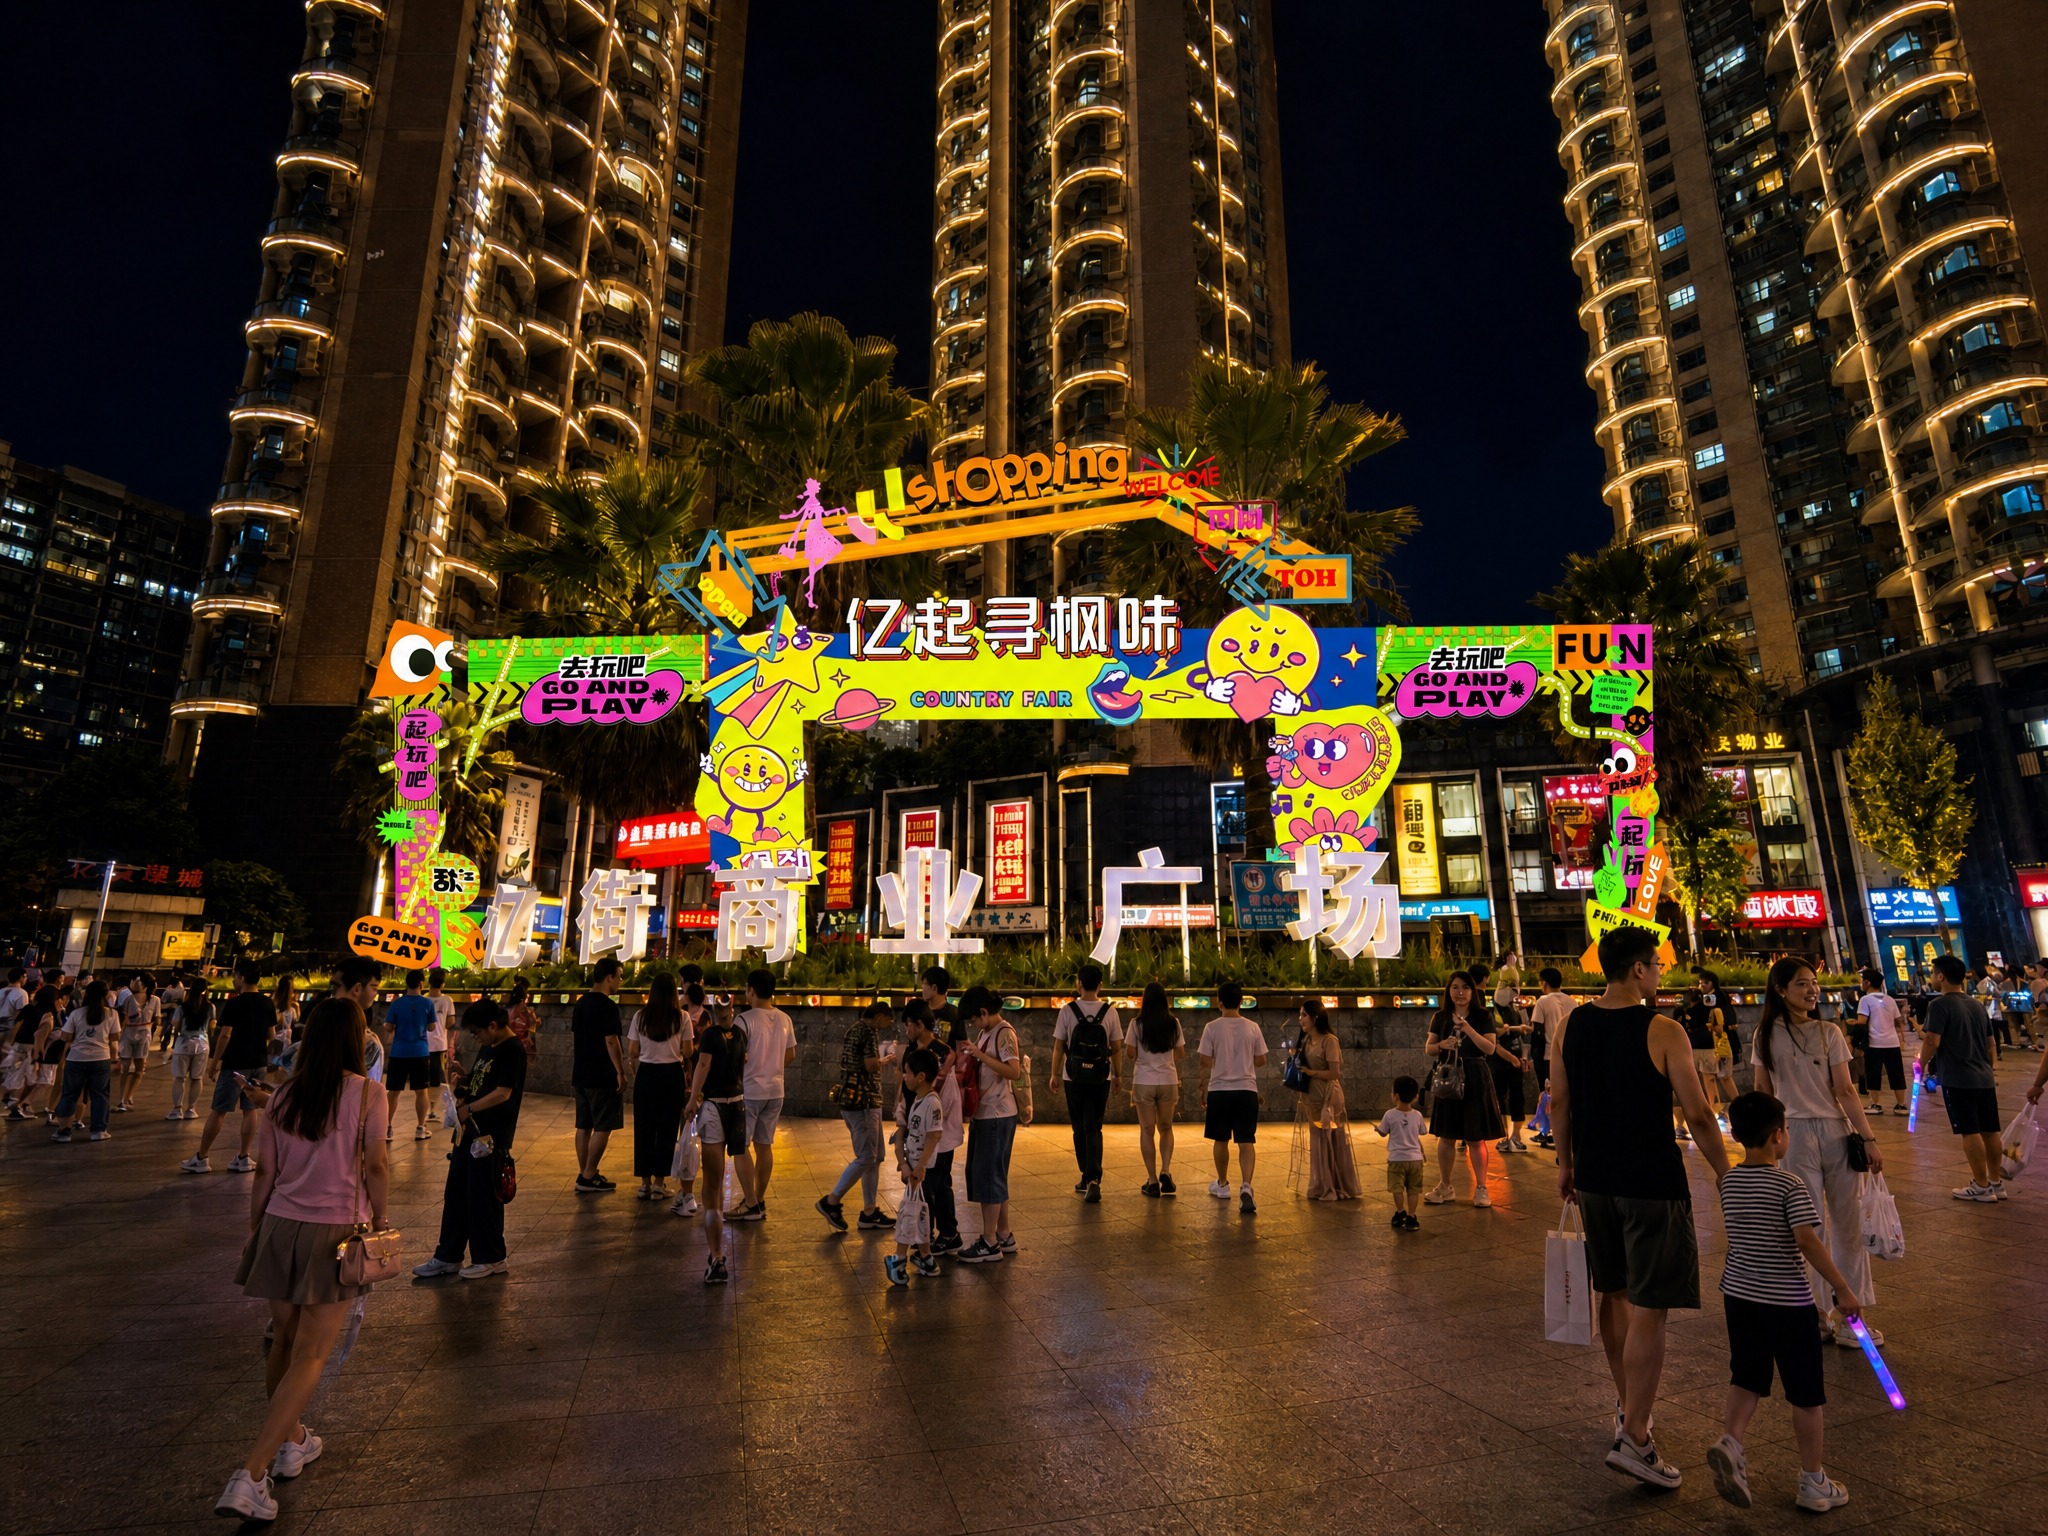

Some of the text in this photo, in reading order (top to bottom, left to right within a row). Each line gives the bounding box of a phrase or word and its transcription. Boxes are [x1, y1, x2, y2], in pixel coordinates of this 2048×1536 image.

[906, 442, 1128, 513] shopping
[846, 594, 1180, 659] 亿起寻枫味
[1430, 647, 1506, 671] 去玩吧
[1557, 633, 1647, 665] FUN
[560, 655, 646, 679] 去玩吧
[1413, 672, 1509, 687] GO AND
[541, 680, 650, 695] GO AND
[910, 690, 1073, 708] COUNTRY FAIR
[1413, 690, 1507, 708] PLAY
[541, 698, 648, 715] PLAY
[405, 713, 429, 788] 一起玩吧
[1637, 853, 1663, 914] LOVE
[356, 921, 432, 947] GO AND
[353, 934, 429, 961] PLAY
